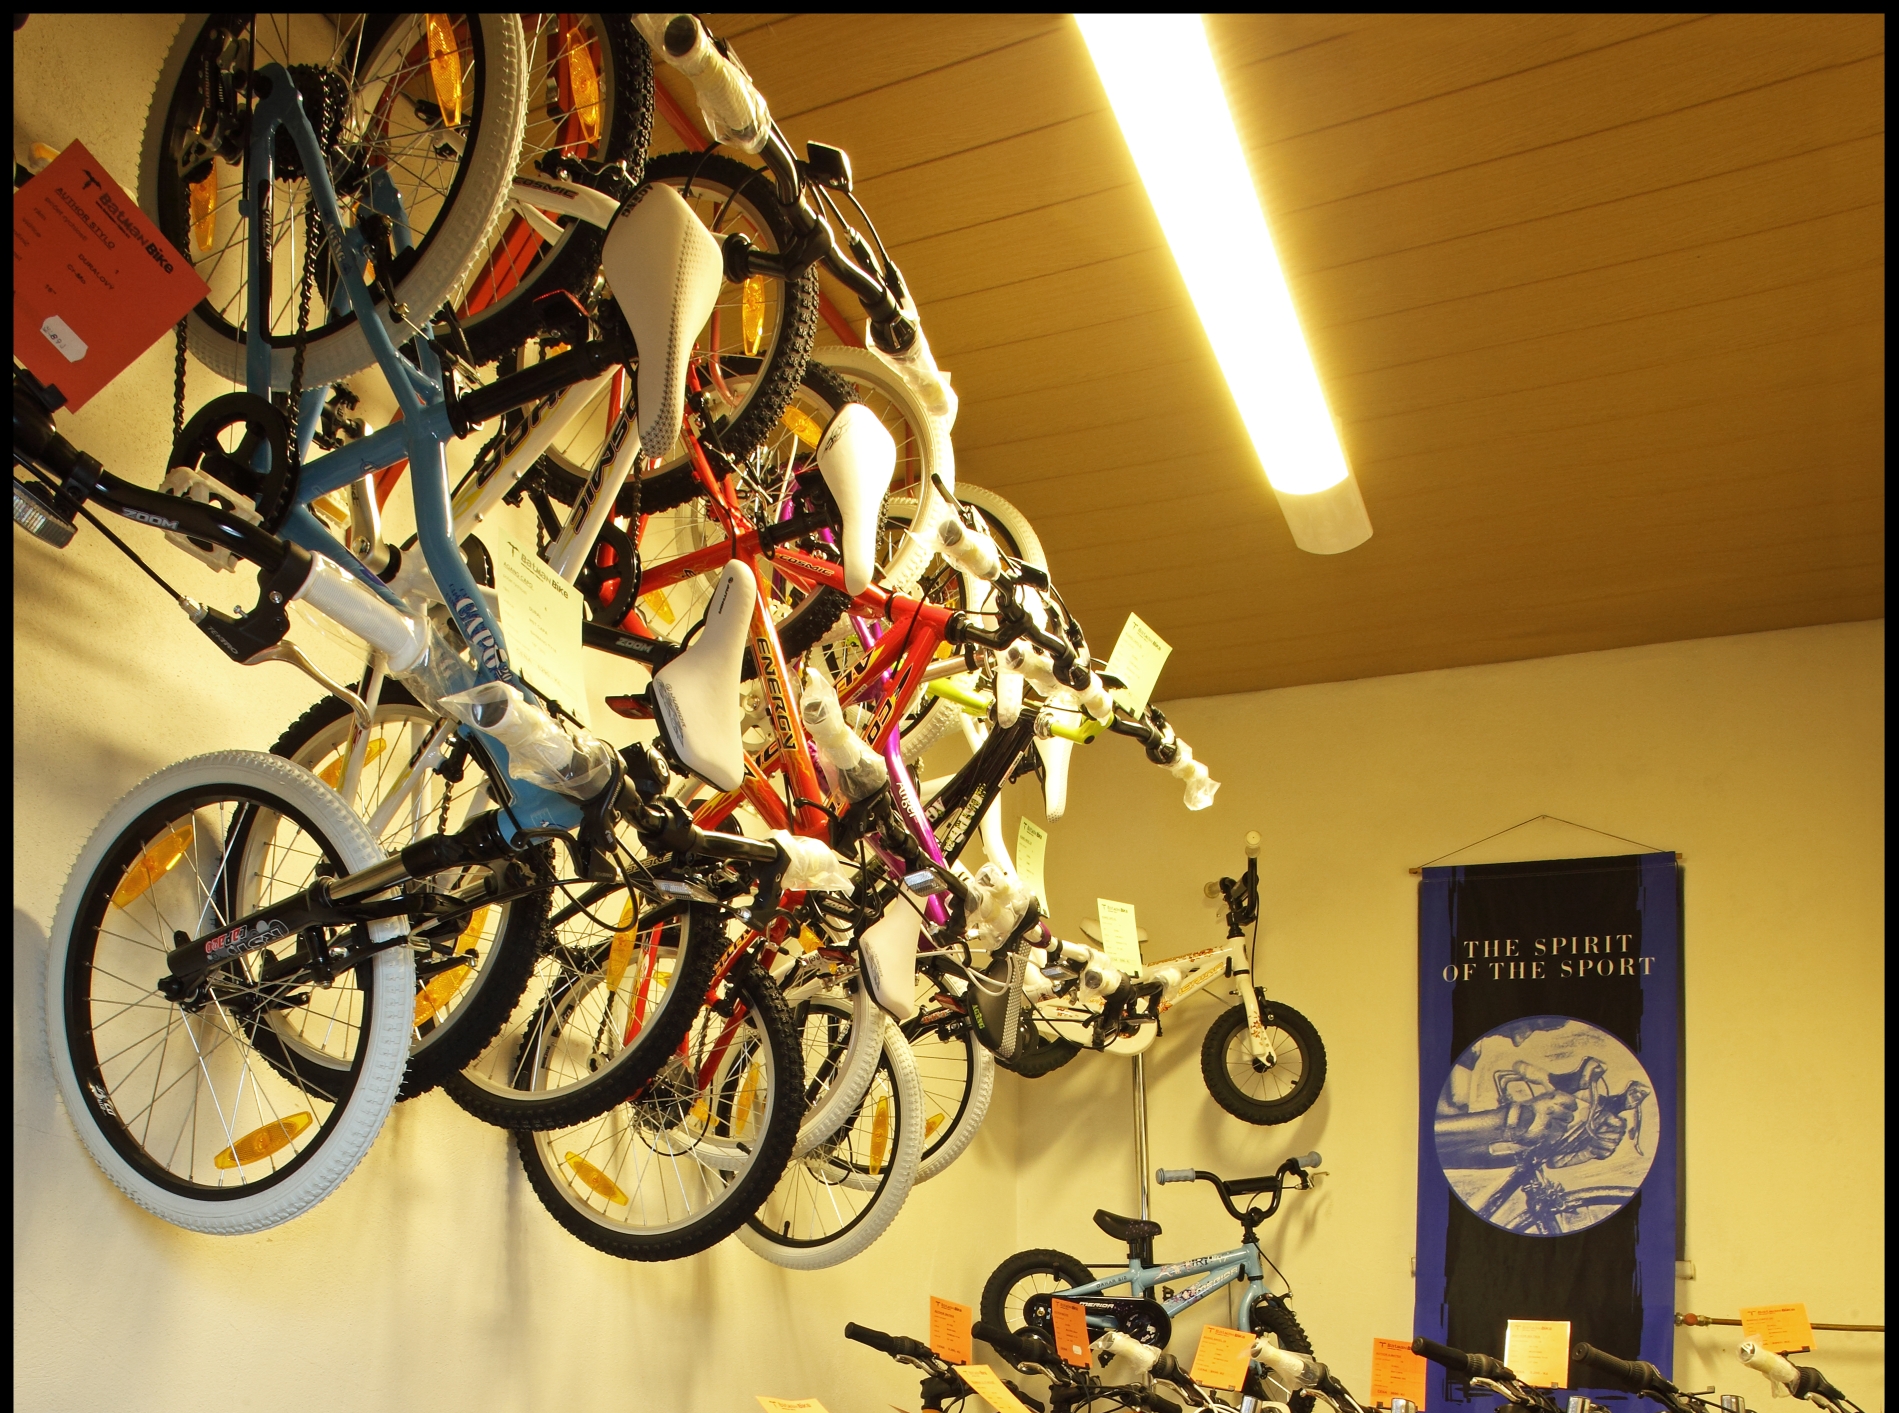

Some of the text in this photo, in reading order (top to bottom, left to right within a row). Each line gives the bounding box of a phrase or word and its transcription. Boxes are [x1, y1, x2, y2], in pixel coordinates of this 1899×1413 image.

[513, 176, 579, 200] COSMIC
[54, 187, 116, 250] AUTHOR STYLO
[571, 396, 638, 535] OSMIC
[121, 506, 180, 530] ZOOM
[778, 553, 835, 577] COSMIC
[207, 625, 239, 655] TEKTRO
[614, 636, 654, 654] ZOOM
[756, 636, 799, 751] ENERGY
[821, 899, 855, 915] ZOOM
[1463, 934, 1633, 959] THE SPIRIT
[1177, 961, 1224, 996] ERIDA
[1442, 956, 1656, 983] OF THE SPORT
[1195, 1266, 1239, 1295] MERIDA
[1079, 1301, 1115, 1309] MERIDA
